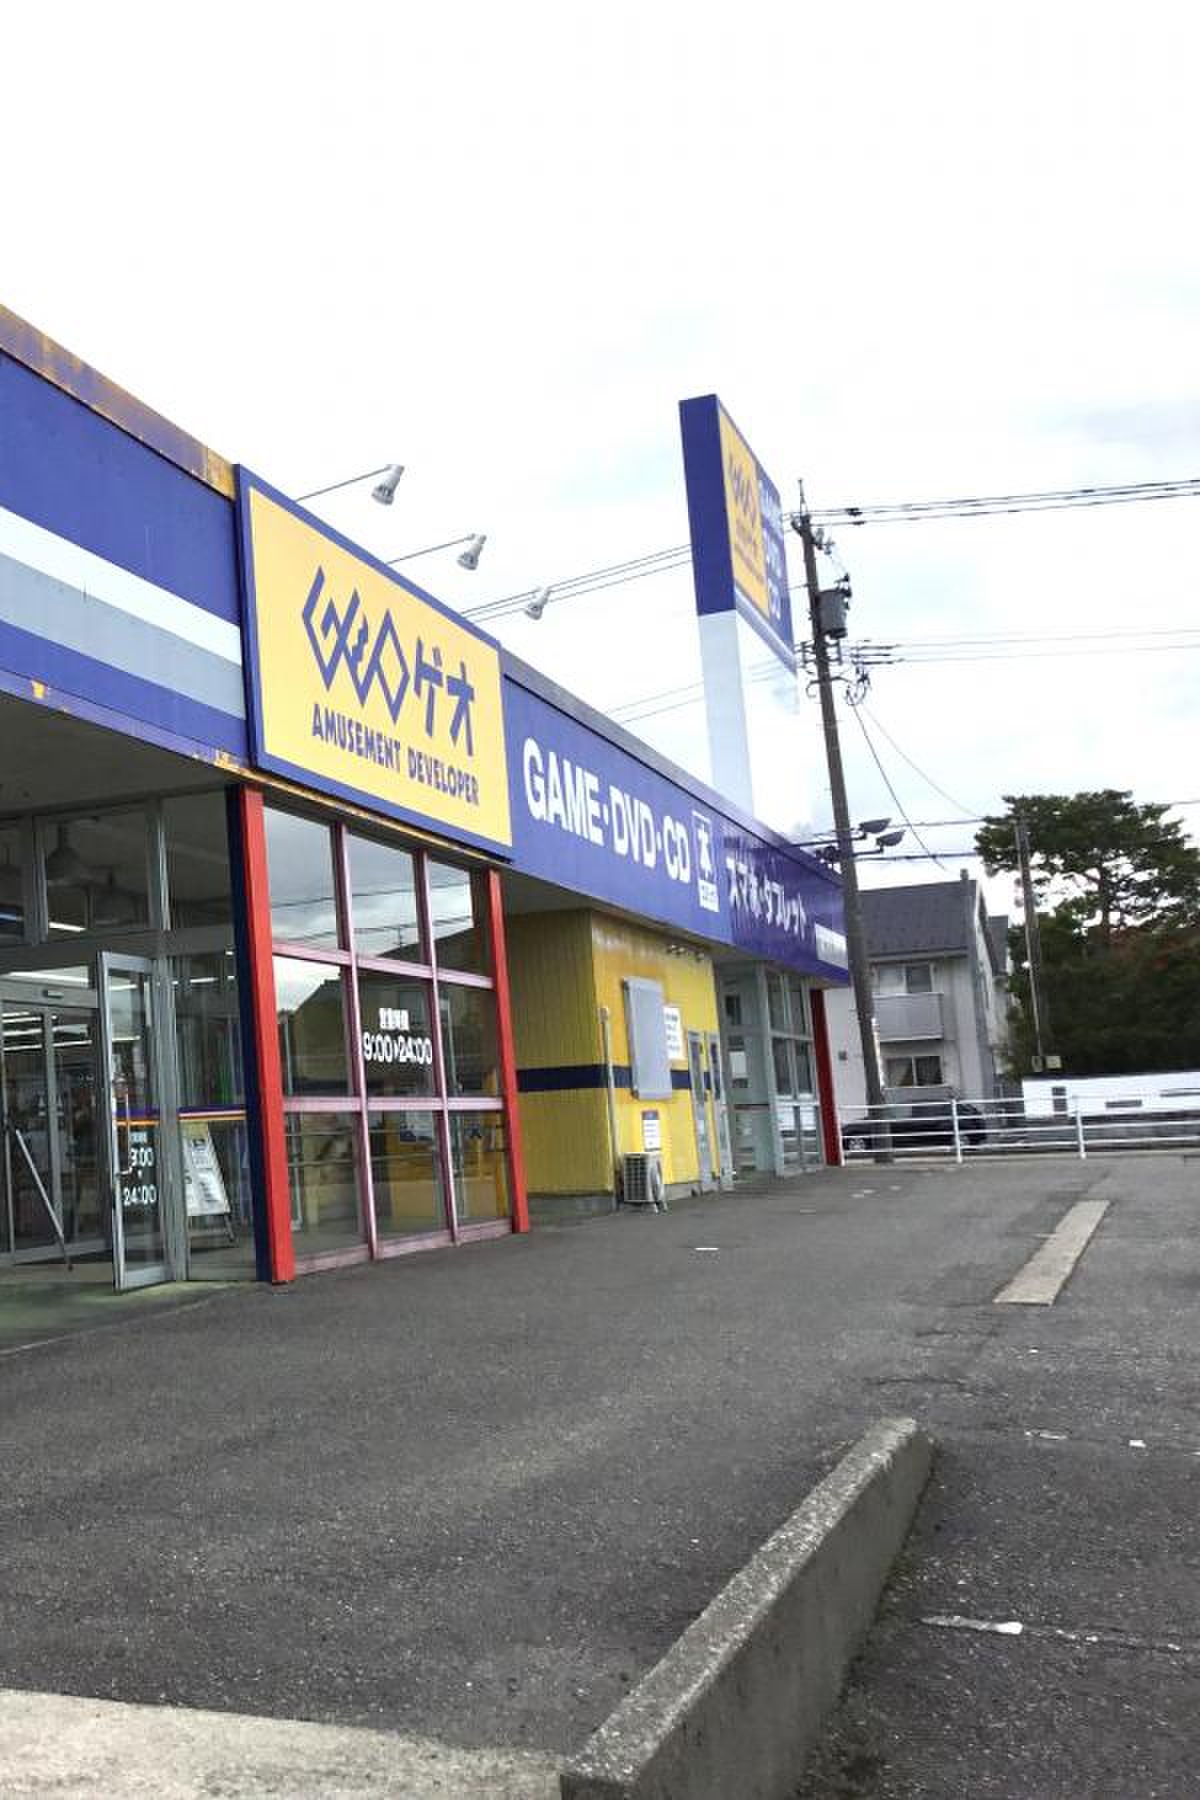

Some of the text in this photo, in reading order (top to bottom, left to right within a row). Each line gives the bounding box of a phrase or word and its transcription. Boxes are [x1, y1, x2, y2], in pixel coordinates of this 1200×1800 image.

[413, 637, 476, 757] ゲオ
[312, 703, 480, 806] AMUSEMENT DEVELOPER
